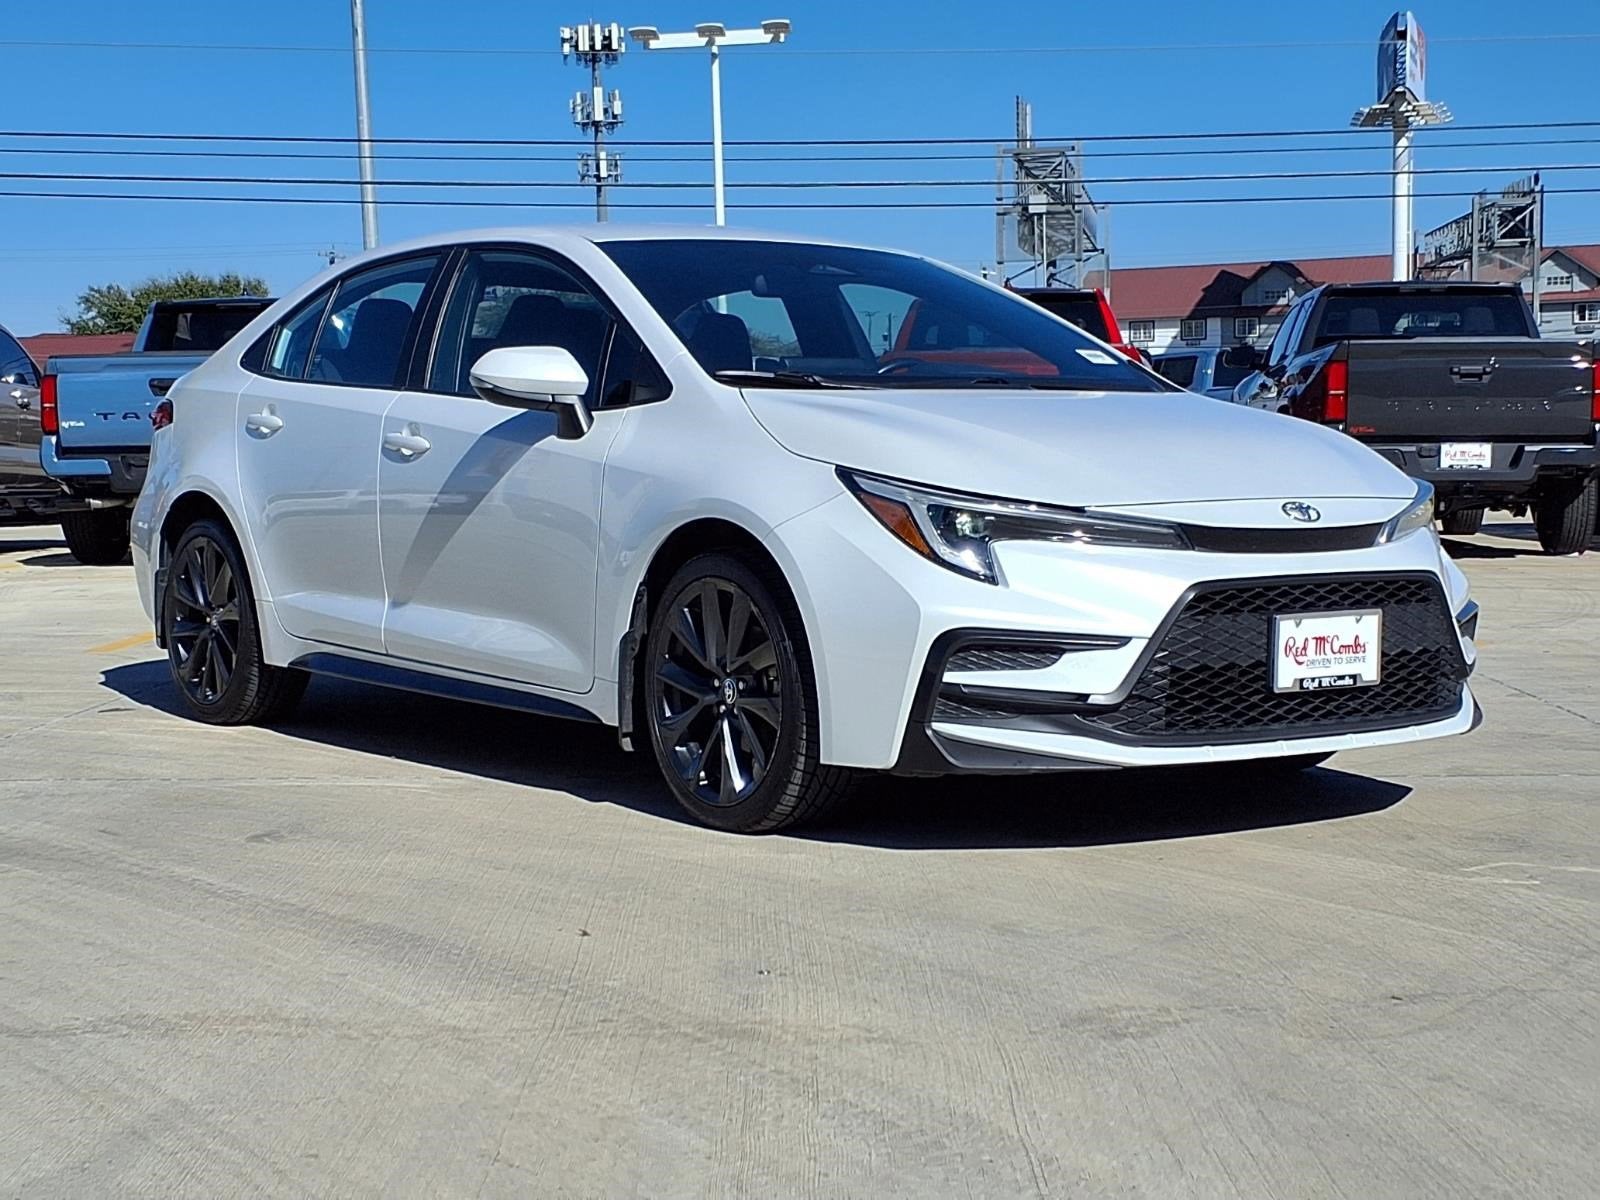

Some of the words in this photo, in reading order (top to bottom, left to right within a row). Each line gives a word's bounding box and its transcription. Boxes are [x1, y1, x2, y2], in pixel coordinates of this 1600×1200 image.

[1284, 636, 1309, 665] Red
[1306, 658, 1332, 667] DRIVEN
[1334, 656, 1344, 665] TO
[1345, 656, 1367, 664] SERVE
